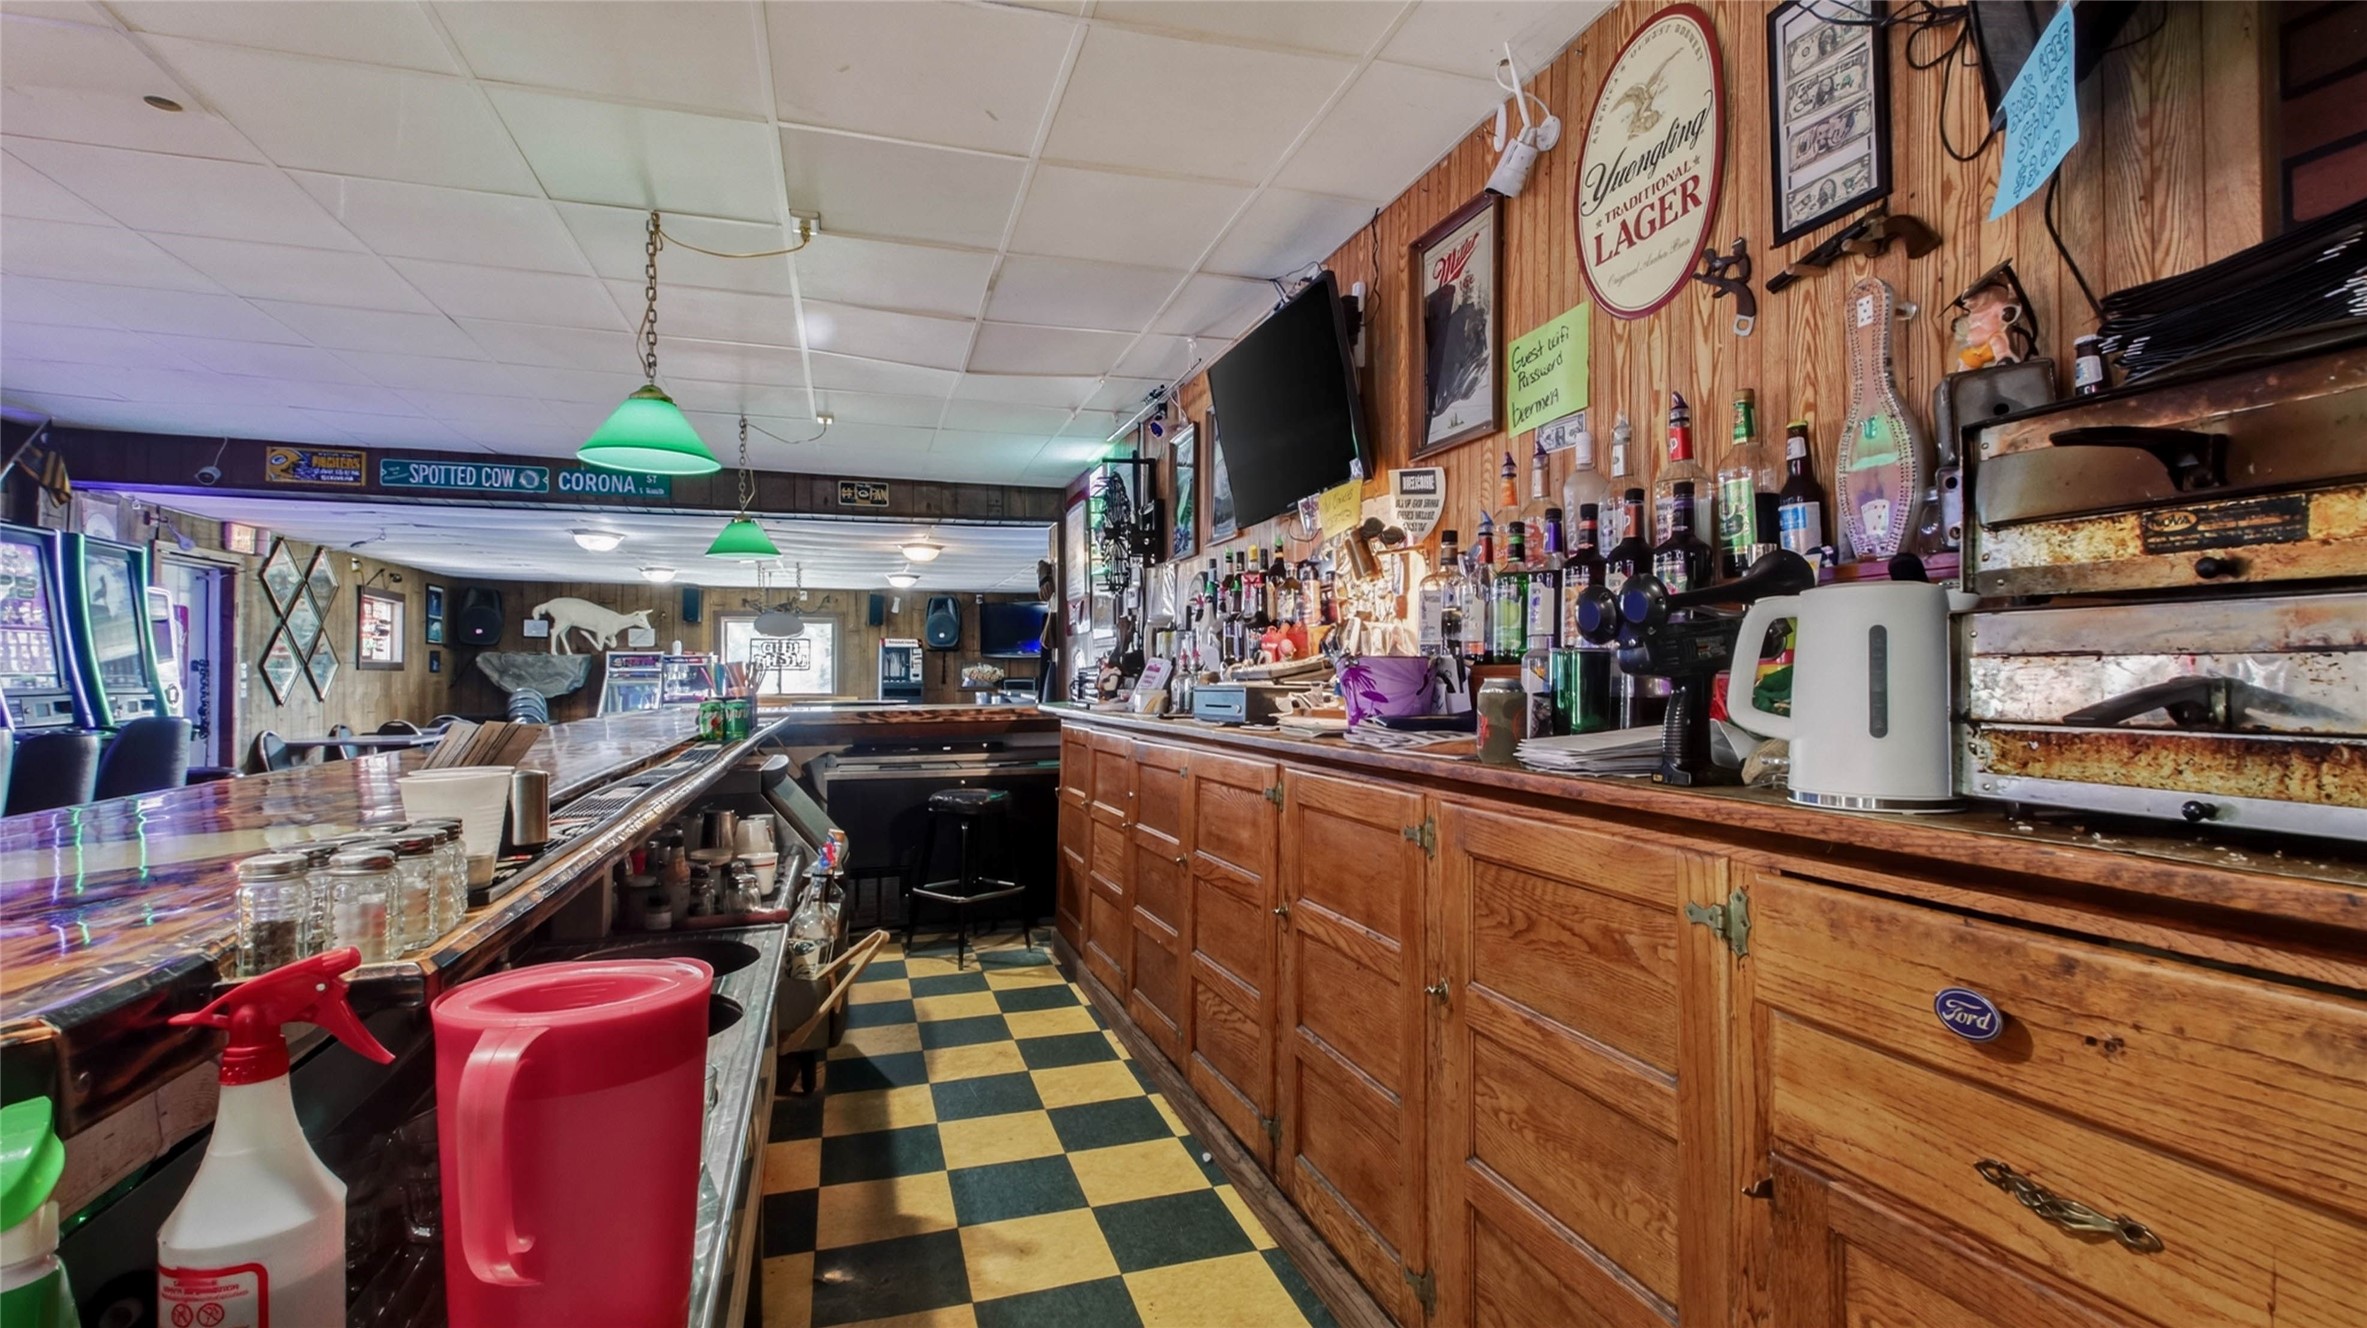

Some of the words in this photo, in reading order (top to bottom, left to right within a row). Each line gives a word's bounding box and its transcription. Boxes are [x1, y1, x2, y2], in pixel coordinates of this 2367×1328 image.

[1580, 90, 1713, 217] Yuengling
[1604, 160, 1692, 224] TRADITIONAL
[1593, 174, 1703, 267] LAGER
[1432, 232, 1480, 287] Miller
[1511, 339, 1545, 373] Guest
[408, 463, 477, 486] SPOTTED
[481, 467, 516, 488] COW
[558, 471, 637, 494] CORONA
[1942, 999, 1992, 1030] Ford
